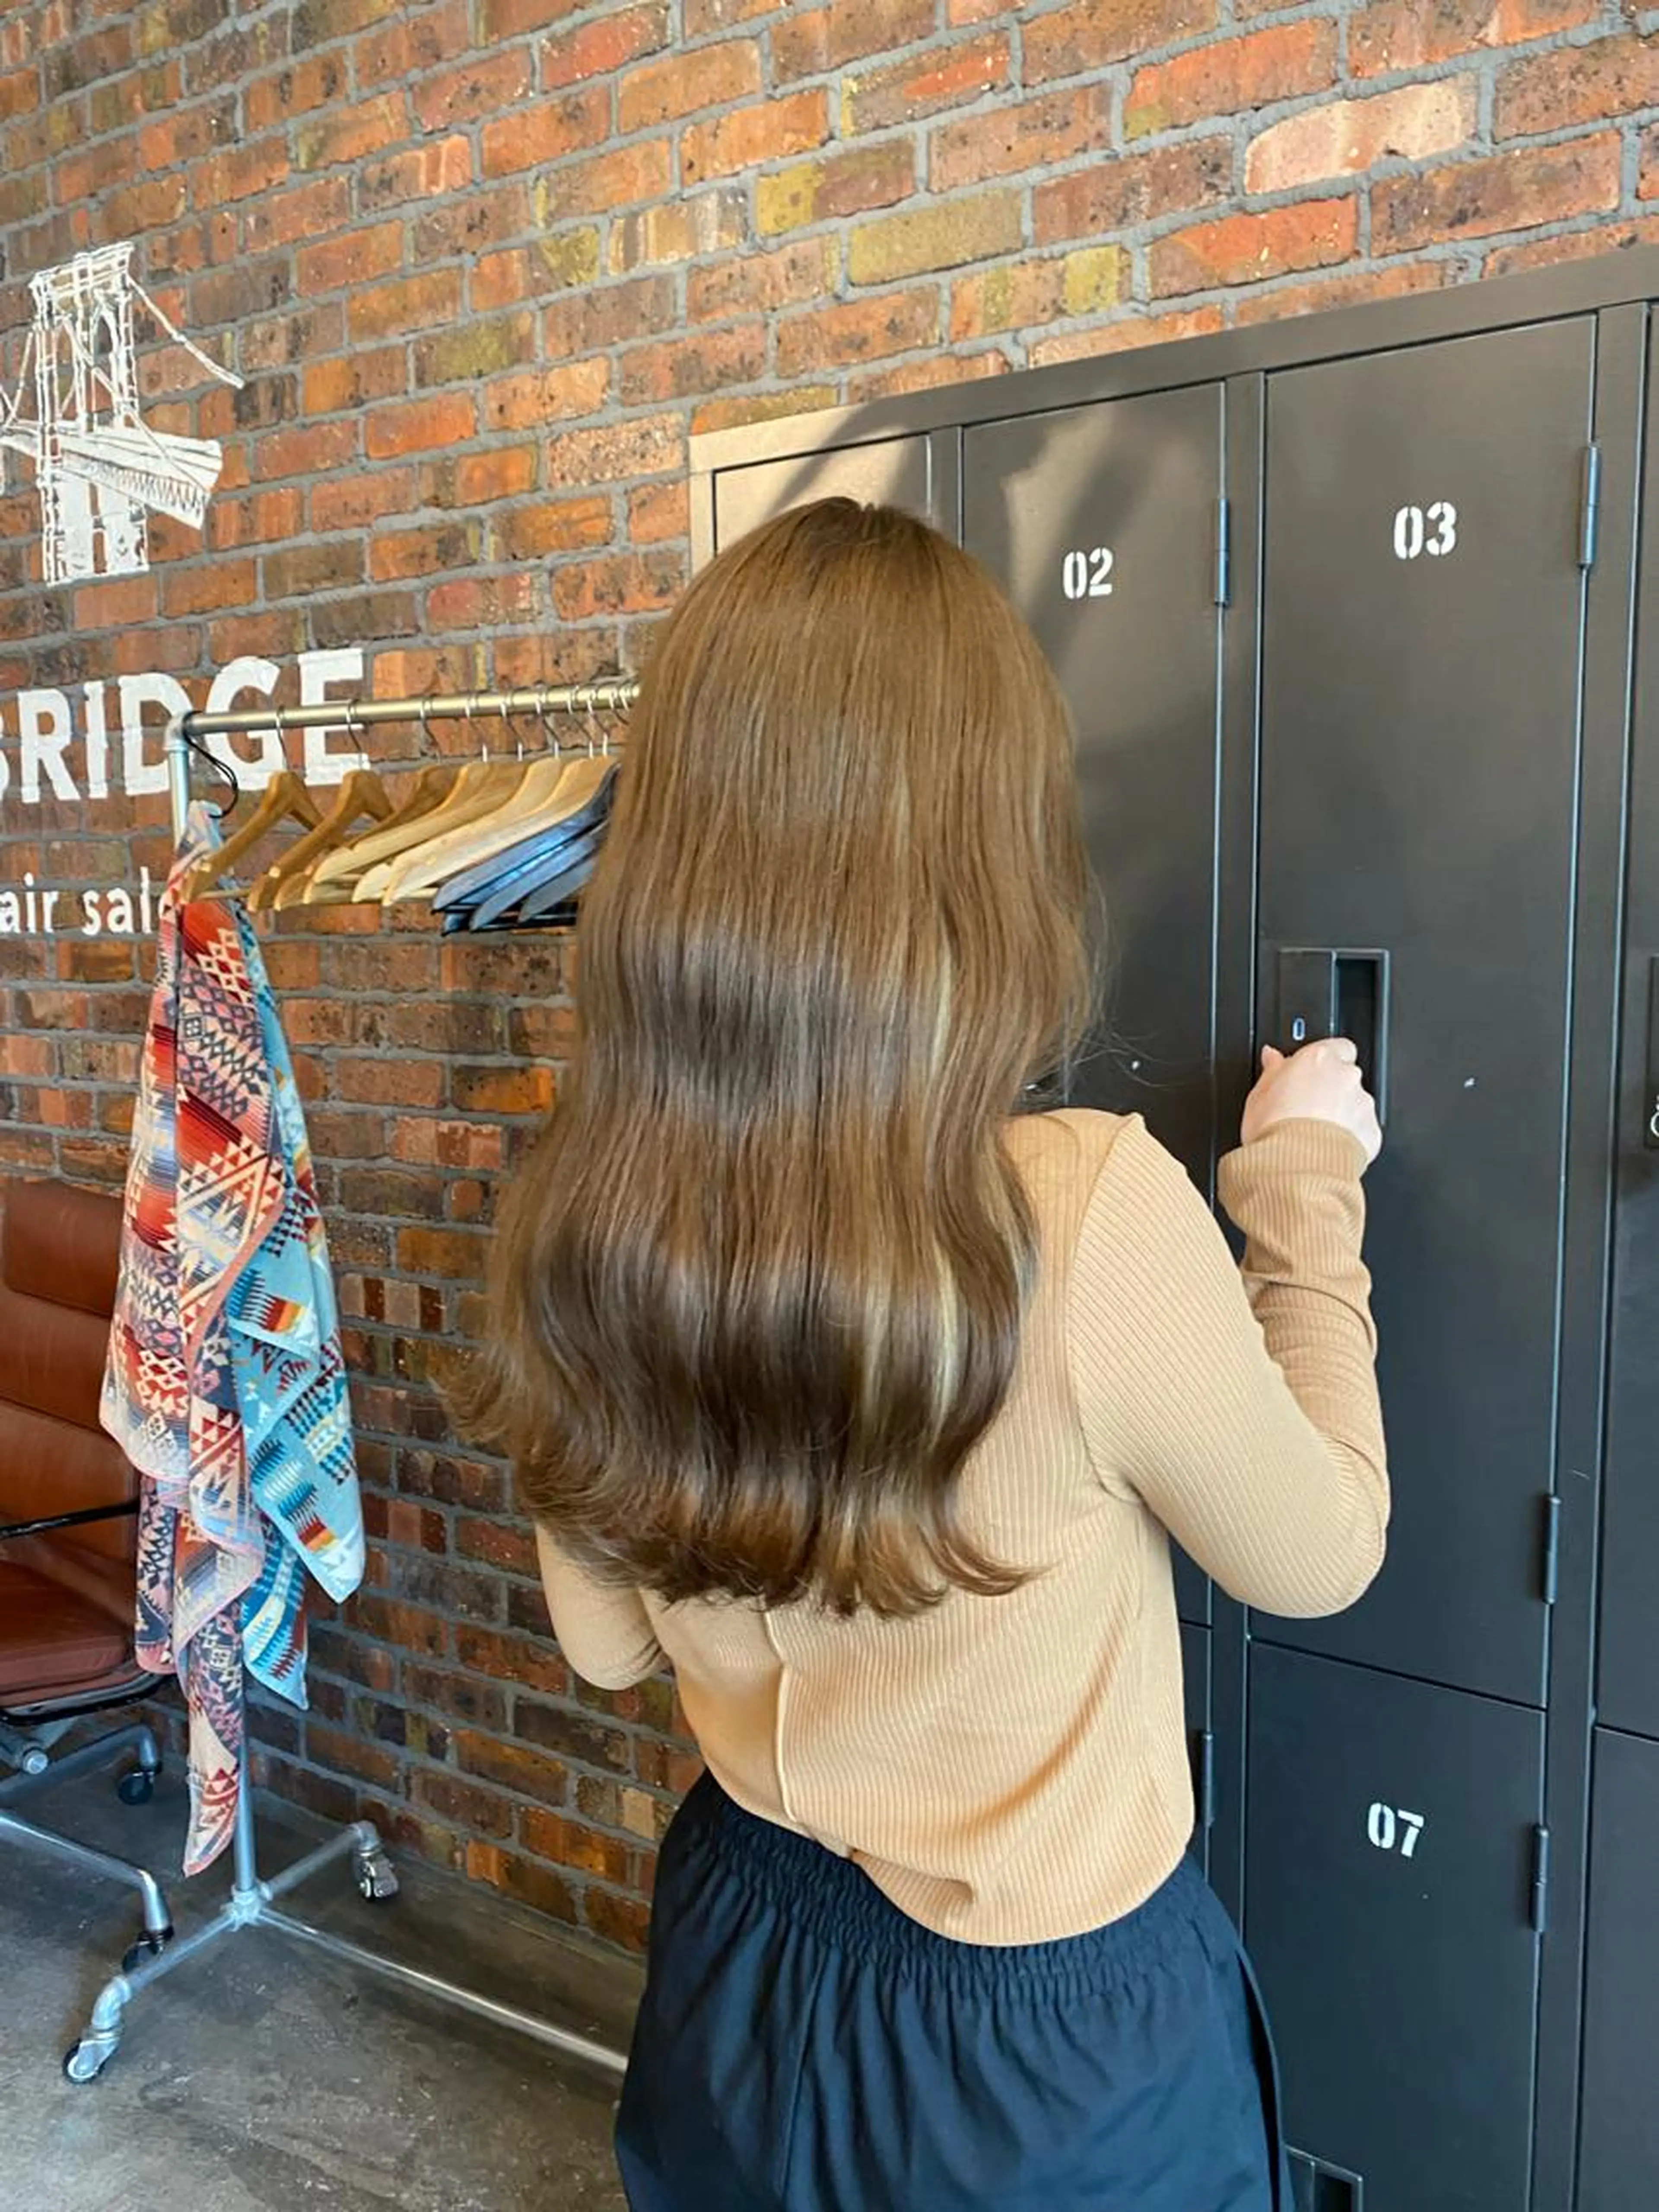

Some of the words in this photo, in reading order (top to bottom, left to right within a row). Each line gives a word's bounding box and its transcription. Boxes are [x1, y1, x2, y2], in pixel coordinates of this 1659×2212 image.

[1394, 502, 1457, 559] 03
[1063, 547, 1113, 599] 02
[0, 647, 371, 804] RIDGE
[0, 872, 59, 934] air
[81, 866, 166, 936] sal
[1367, 1802, 1425, 1858] 07
